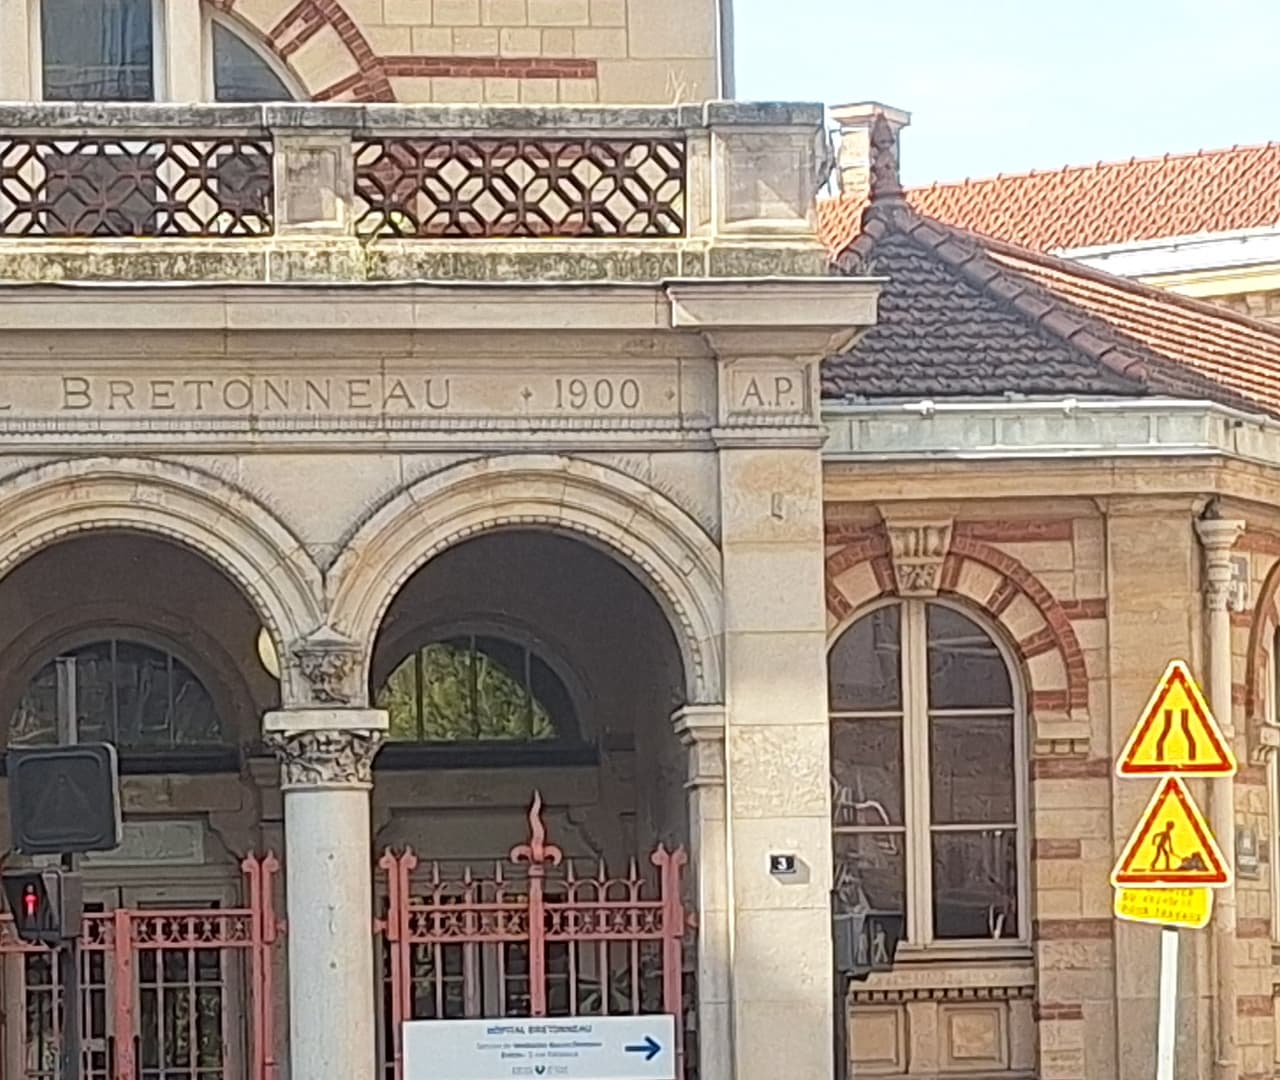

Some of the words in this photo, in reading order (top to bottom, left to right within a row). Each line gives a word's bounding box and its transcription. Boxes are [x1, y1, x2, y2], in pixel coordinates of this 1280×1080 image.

[61, 375, 451, 411] BRETONNEAU
[555, 378, 640, 410] 1900
[776, 856, 788, 870] 3
